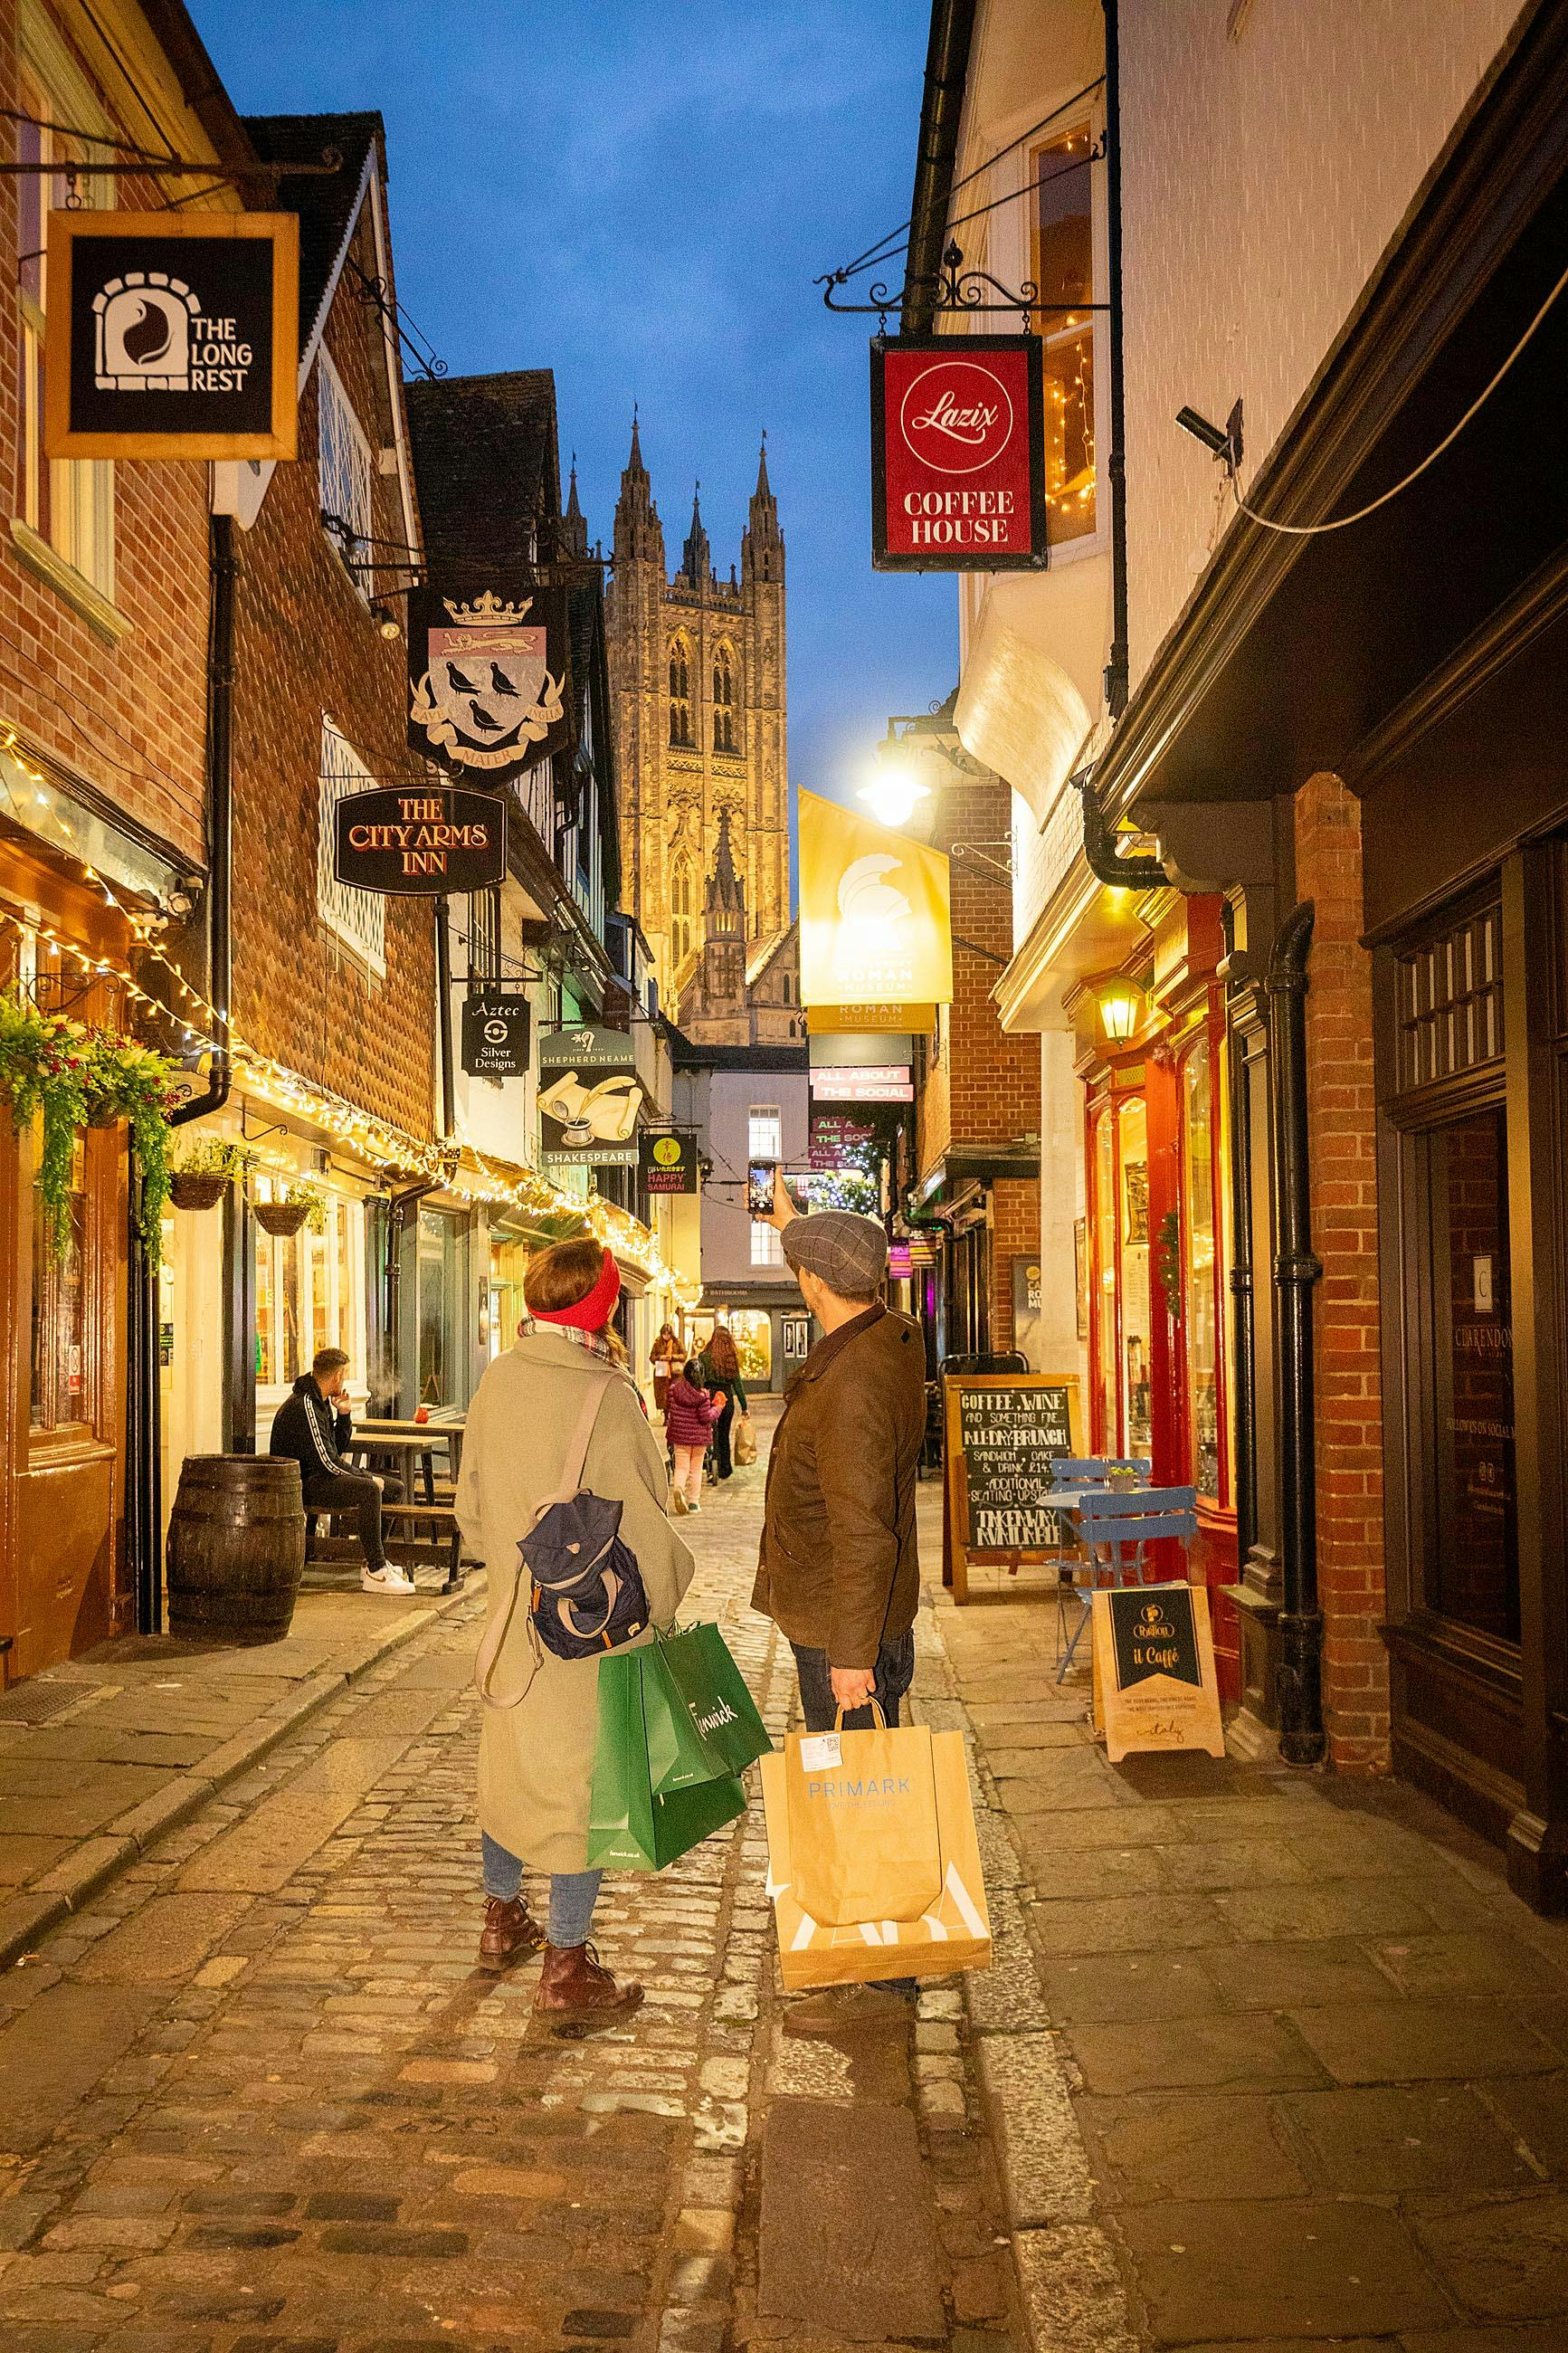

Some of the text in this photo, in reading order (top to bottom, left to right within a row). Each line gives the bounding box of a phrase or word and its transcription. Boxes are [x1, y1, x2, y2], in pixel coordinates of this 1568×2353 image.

[191, 318, 237, 341] THE
[191, 343, 253, 367] LONG
[191, 368, 249, 392] REST
[911, 391, 998, 444] Lazix
[904, 491, 1014, 516] COFFEE
[912, 519, 1009, 544] HOUSE
[462, 749, 512, 767] MATER
[398, 798, 444, 823] THE
[348, 824, 491, 852] CITY ARMS
[401, 852, 448, 876] INN
[471, 1001, 520, 1016] Aztec
[839, 1004, 903, 1014] ROMAN
[480, 1047, 512, 1058] Silver
[542, 1054, 634, 1064] SHEPHERD NEAME
[475, 1058, 517, 1072] Designs
[817, 1071, 901, 1081] ALL ABOUT
[822, 1087, 909, 1098] THE SOCIAL
[818, 1120, 841, 1129] ALL
[816, 1135, 841, 1143] THE
[546, 1151, 633, 1164] SHAKESPEARE
[647, 1183, 685, 1191] SAMURAI
[648, 1174, 685, 1183] HAPPY
[965, 1412, 983, 1424] AND
[990, 1412, 1036, 1424] SOMETHING
[982, 1462, 992, 1473] &
[997, 1462, 1024, 1473] DRINK
[976, 1510, 1057, 1529] TAKEAWAY
[976, 1525, 1060, 1547] AVAILABLE
[1134, 1647, 1144, 1665] il
[688, 1695, 739, 1741] Fenwick
[809, 1777, 911, 1799] PRIMARK
